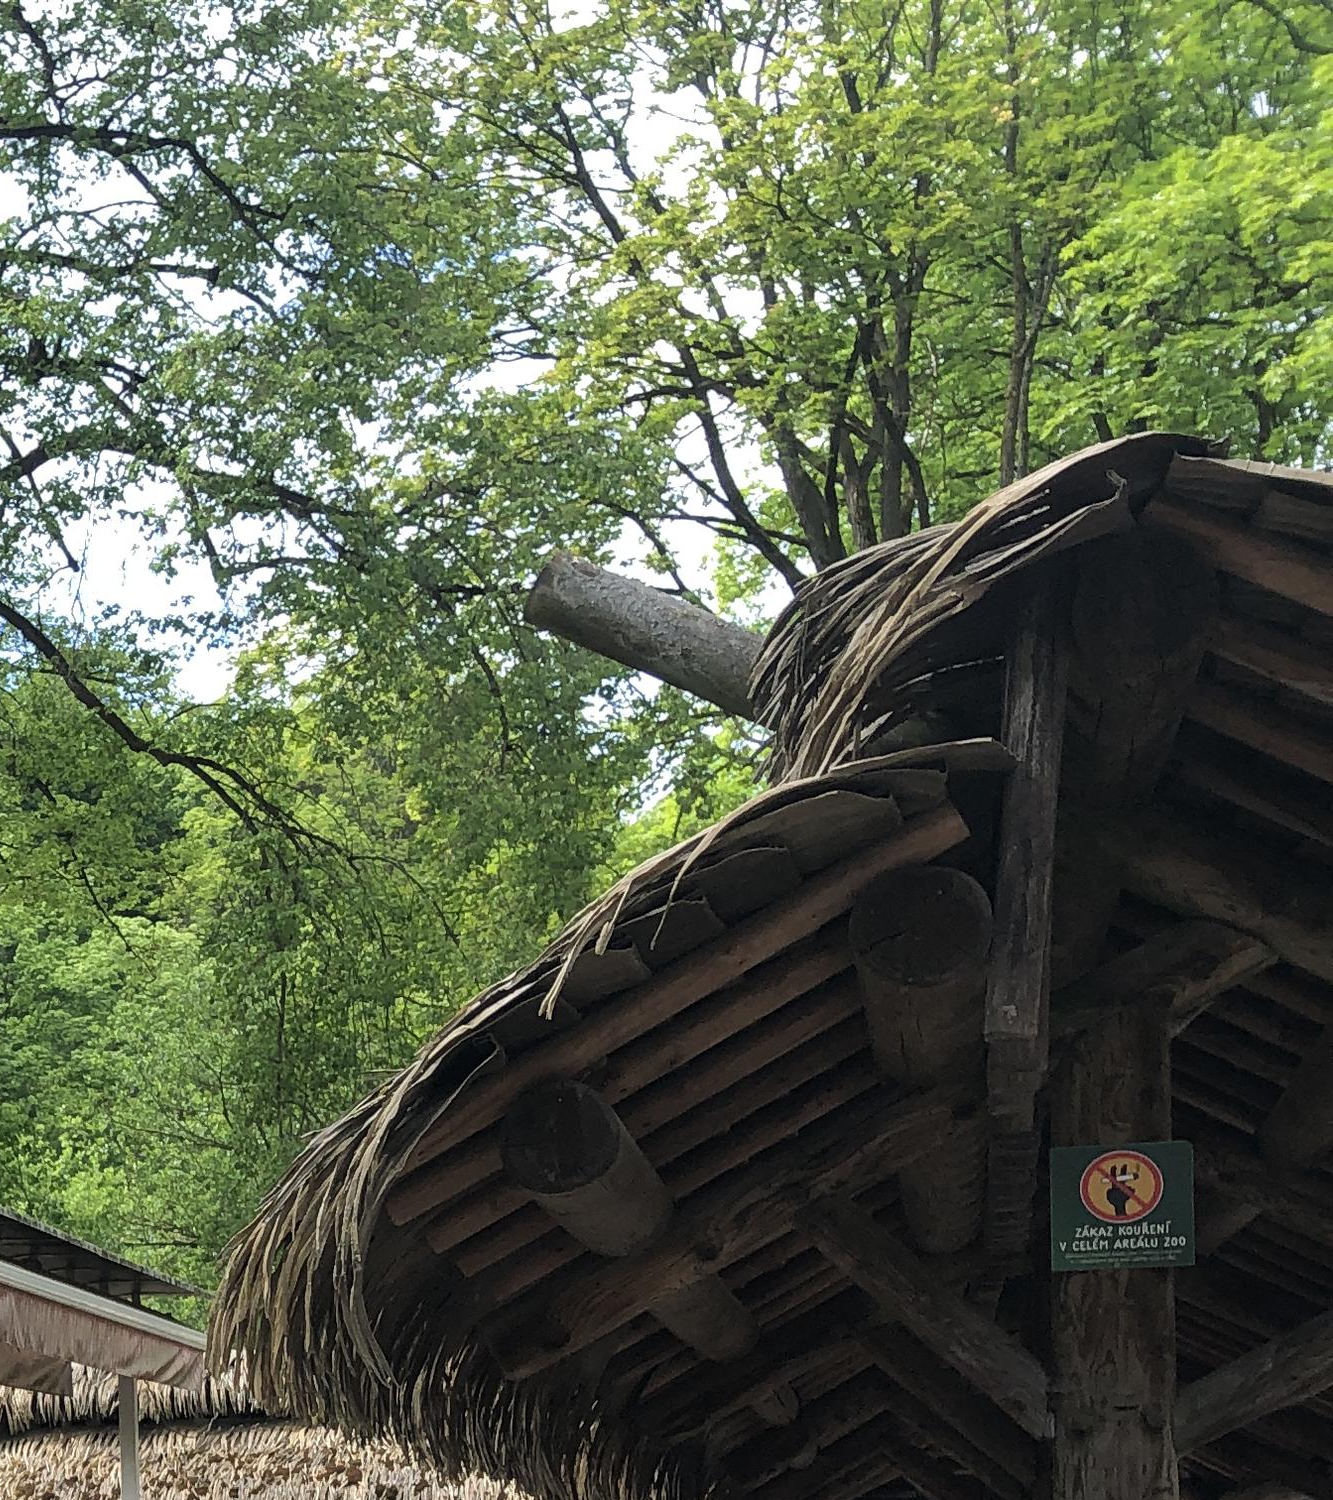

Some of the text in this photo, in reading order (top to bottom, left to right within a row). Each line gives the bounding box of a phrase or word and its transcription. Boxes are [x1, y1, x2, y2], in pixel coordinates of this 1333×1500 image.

[1075, 1221, 1172, 1238] ZÁKAZ KOUŘENÍ
[1059, 1236, 1187, 1252] V CELÉM AREÁLU ZOO
